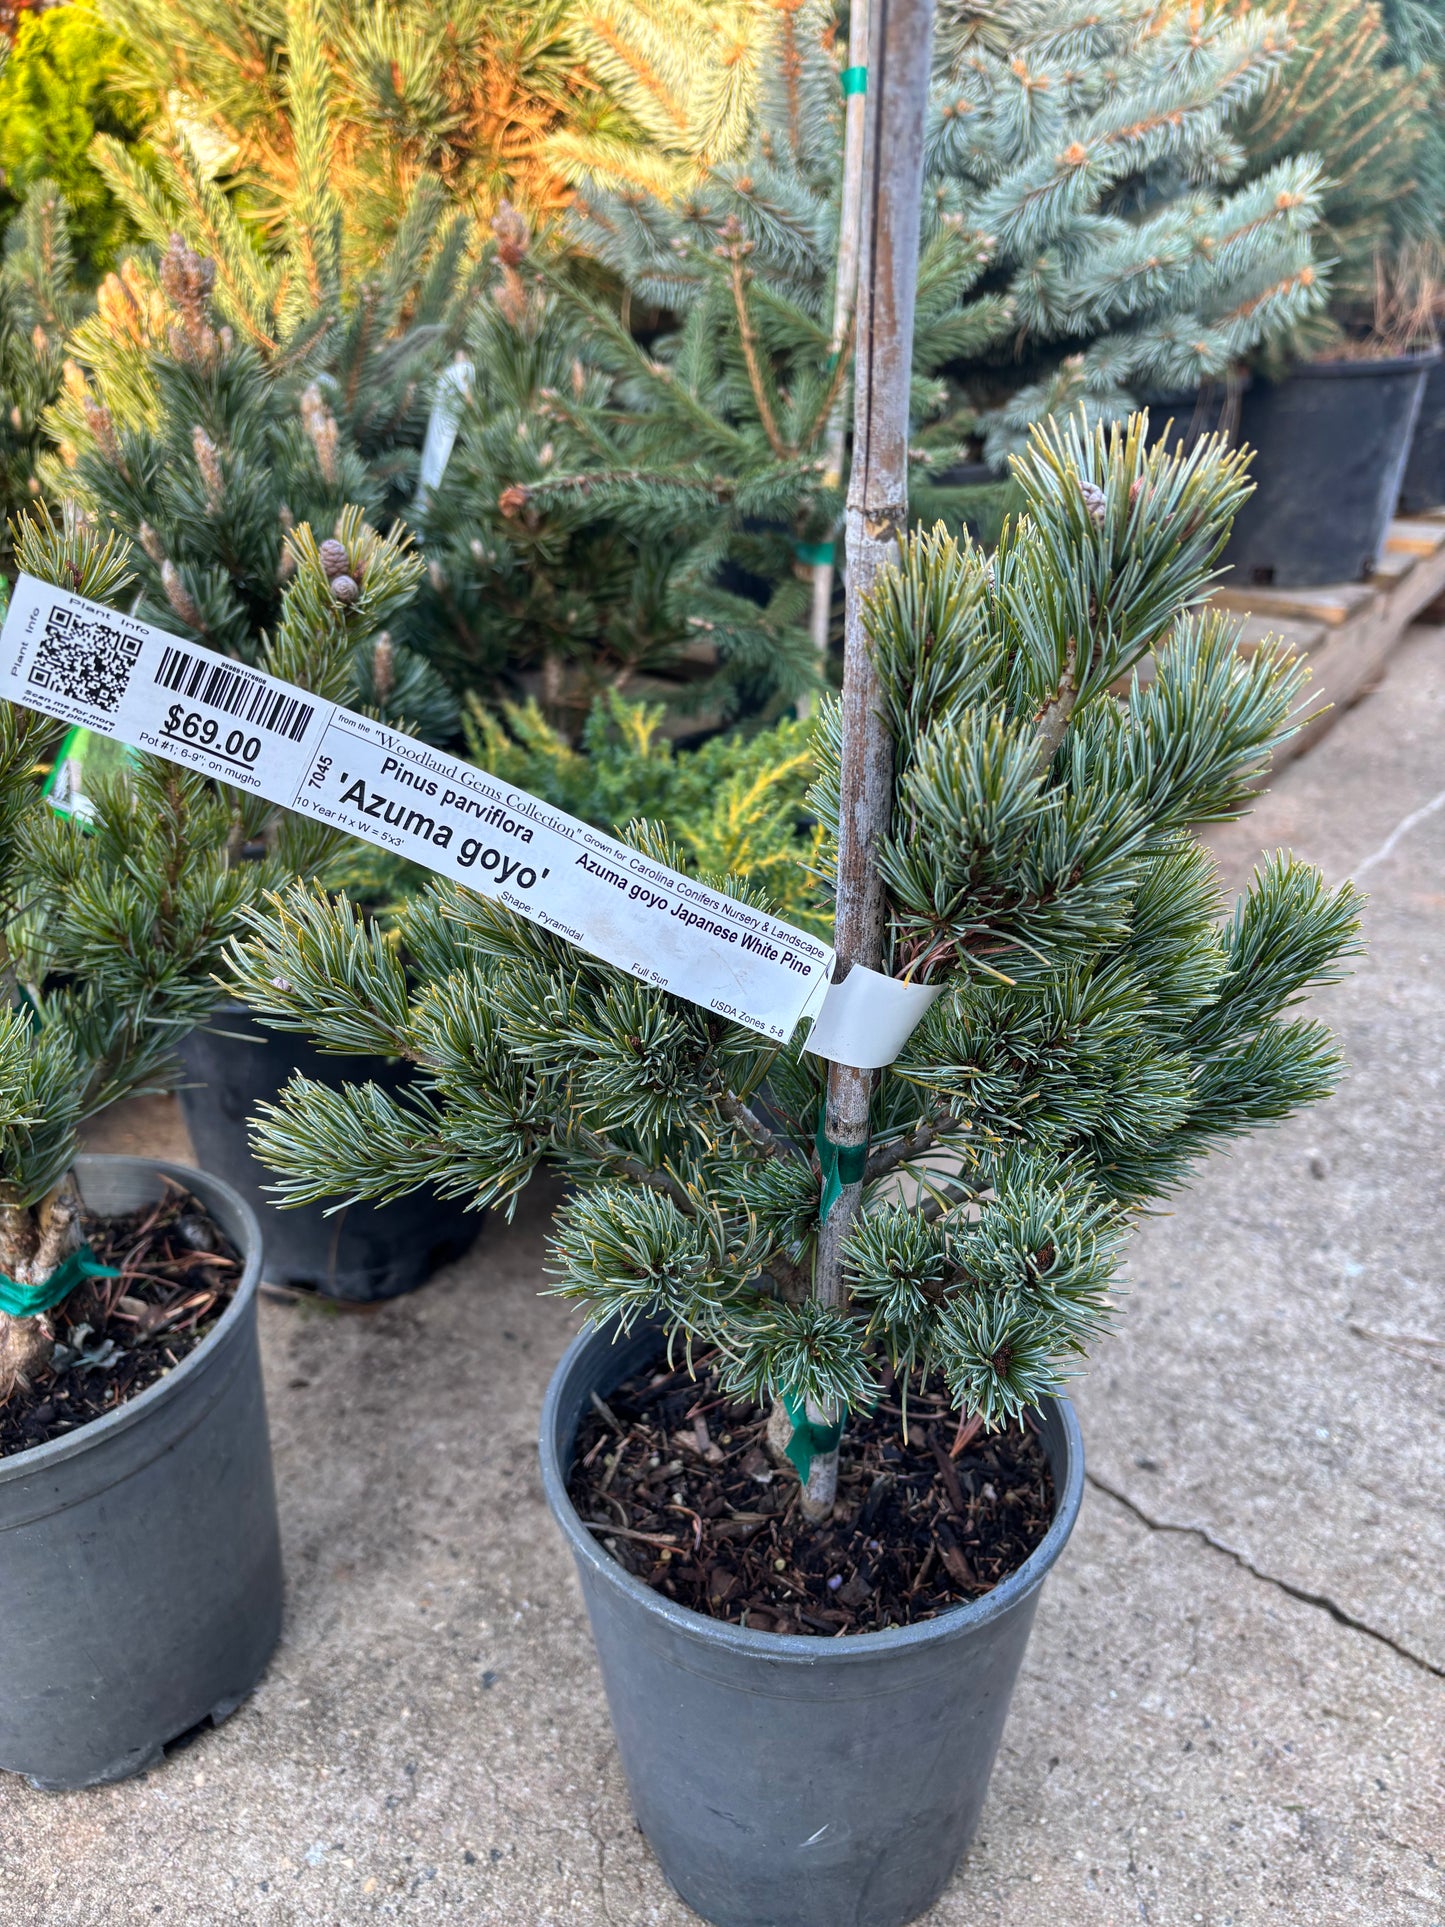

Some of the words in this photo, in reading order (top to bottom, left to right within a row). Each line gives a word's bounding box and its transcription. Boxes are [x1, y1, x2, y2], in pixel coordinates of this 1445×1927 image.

[69, 598, 111, 620] Plant
[121, 619, 150, 635] Info
[11, 642, 29, 677] Plant
[26, 608, 40, 633] Info
[24, 689, 51, 703] Scan
[54, 701, 70, 710] me
[73, 707, 89, 715] for
[89, 713, 115, 727] more
[45, 705, 66, 715] and
[164, 704, 261, 762] $69.00
[140, 732, 159, 747] Pot
[161, 741, 178, 755] #1;
[208, 761, 222, 772] on
[224, 766, 261, 788] mugho
[308, 755, 333, 789] 7045
[296, 796, 309, 807] 10
[312, 801, 336, 818] Year
[338, 813, 348, 823] H
[348, 819, 355, 827] x
[359, 821, 371, 833] W
[380, 757, 438, 796] Pinus
[440, 789, 534, 844] parviflora
[338, 714, 356, 728] from
[358, 723, 370, 733] the
[376, 730, 457, 778] "Woodland
[461, 771, 503, 800] Gems
[506, 793, 582, 838] Collection"
[584, 833, 612, 855] Grown
[614, 850, 627, 862] for
[629, 858, 674, 889] Carolina
[676, 883, 720, 910] Conifers
[721, 903, 760, 929] Nursery
[761, 921, 770, 932] &
[771, 925, 825, 959] Landscape
[339, 772, 453, 849] 'Azuma
[456, 837, 550, 889] goyo'
[501, 891, 533, 914] Shape:
[537, 910, 584, 942] Pyramidal
[575, 853, 628, 890] Azuma
[628, 884, 668, 911] goyo
[670, 903, 738, 943] Japanese
[740, 932, 778, 961] White
[779, 951, 812, 976] Pine
[631, 962, 649, 977] Full
[649, 971, 669, 987] Sun
[710, 998, 737, 1017] USDA
[739, 1010, 765, 1030] Zones
[769, 1025, 784, 1038] 5-8
